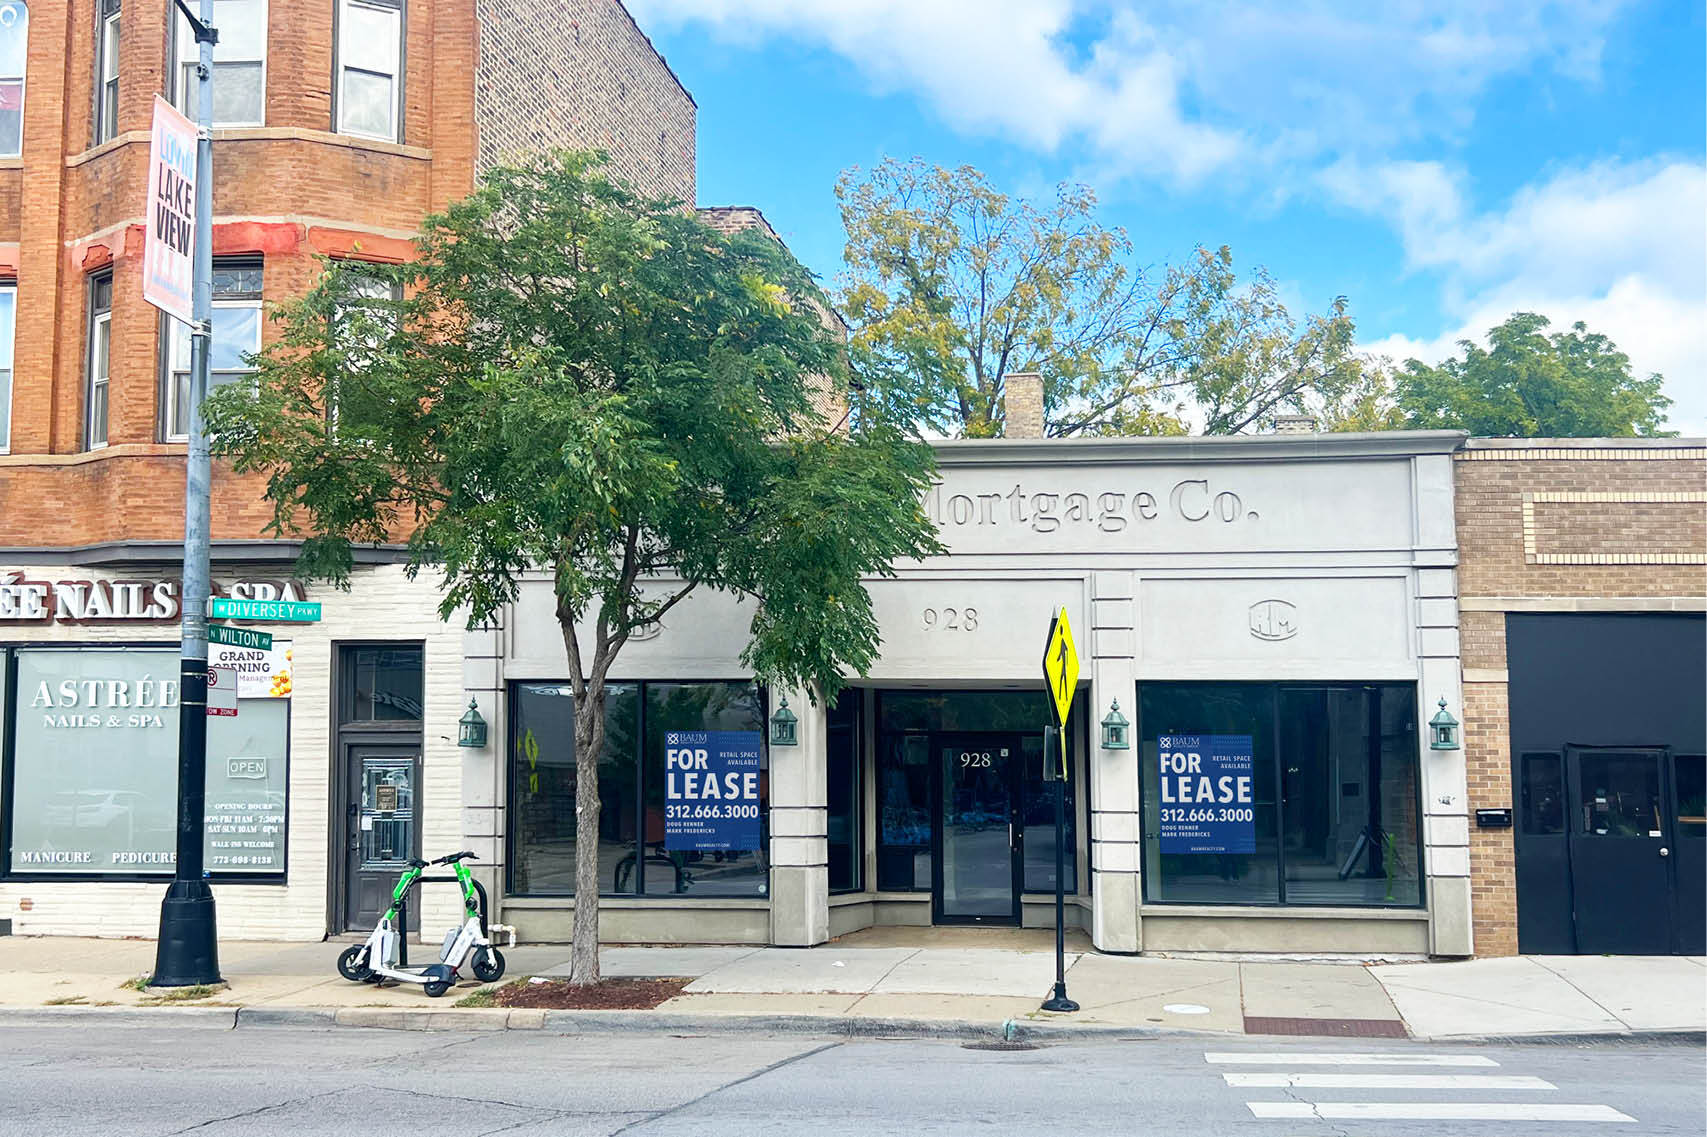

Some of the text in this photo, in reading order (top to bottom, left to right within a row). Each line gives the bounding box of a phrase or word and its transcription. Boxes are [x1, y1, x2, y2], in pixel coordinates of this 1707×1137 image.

[158, 162, 193, 220] LAKE
[156, 201, 192, 258] VIEW
[1170, 479, 1260, 522] Co.
[53, 582, 177, 619] NAILS
[227, 601, 296, 618] DIVERSEY
[297, 607, 318, 616] PKWY
[919, 606, 980, 632] 928
[210, 629, 216, 638] N
[219, 627, 260, 648] WILTON
[219, 651, 265, 661] GRAND
[31, 673, 179, 708] ASTRÉE
[43, 714, 164, 728] NAILS & SPA
[679, 733, 708, 741] BAUM
[230, 762, 264, 773] OPEN
[667, 749, 709, 770] FOR
[960, 752, 991, 768] 928
[1160, 752, 1202, 774] FOR
[667, 772, 758, 800] LEASE
[1161, 776, 1252, 804] LEASE
[666, 804, 759, 818] 312.666.3000
[1161, 808, 1253, 822] 312.666.3000
[20, 851, 178, 864] MANICURE PEDICURE
